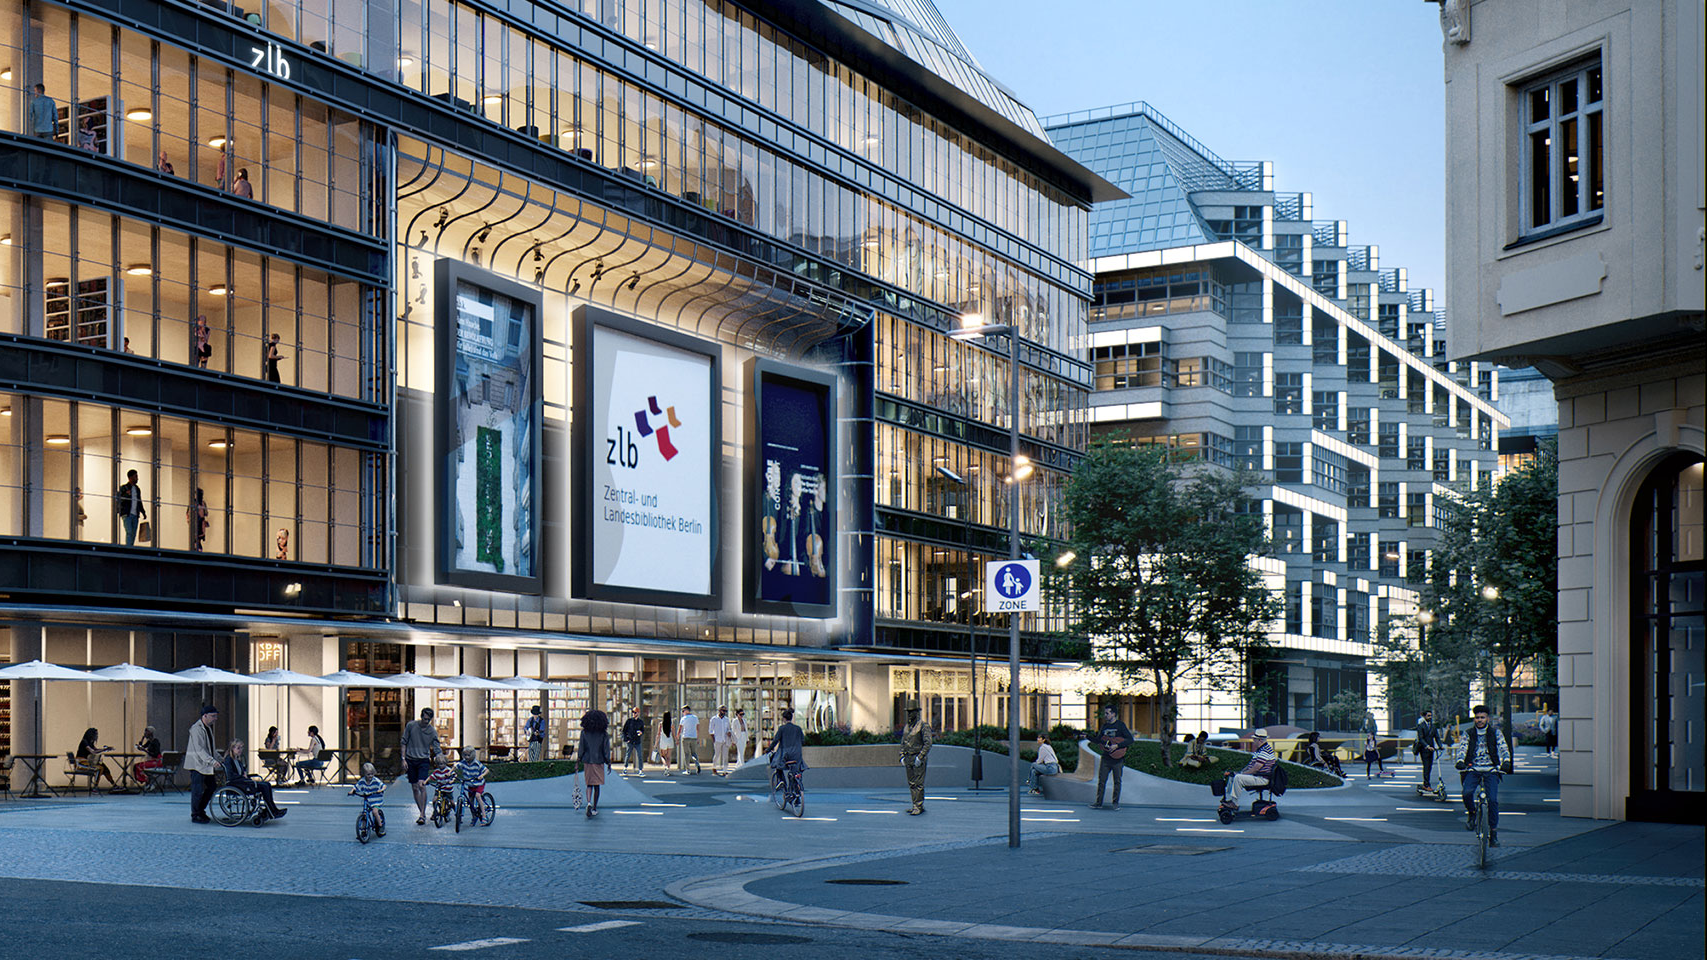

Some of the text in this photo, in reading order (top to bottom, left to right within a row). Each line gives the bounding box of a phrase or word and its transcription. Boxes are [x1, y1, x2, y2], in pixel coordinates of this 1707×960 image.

[252, 41, 290, 80] zlb
[606, 425, 639, 469] zlb
[604, 484, 658, 508] Zentral- und
[604, 505, 703, 534] Landesbibliothek Berlin
[999, 600, 1027, 610] ZONE
